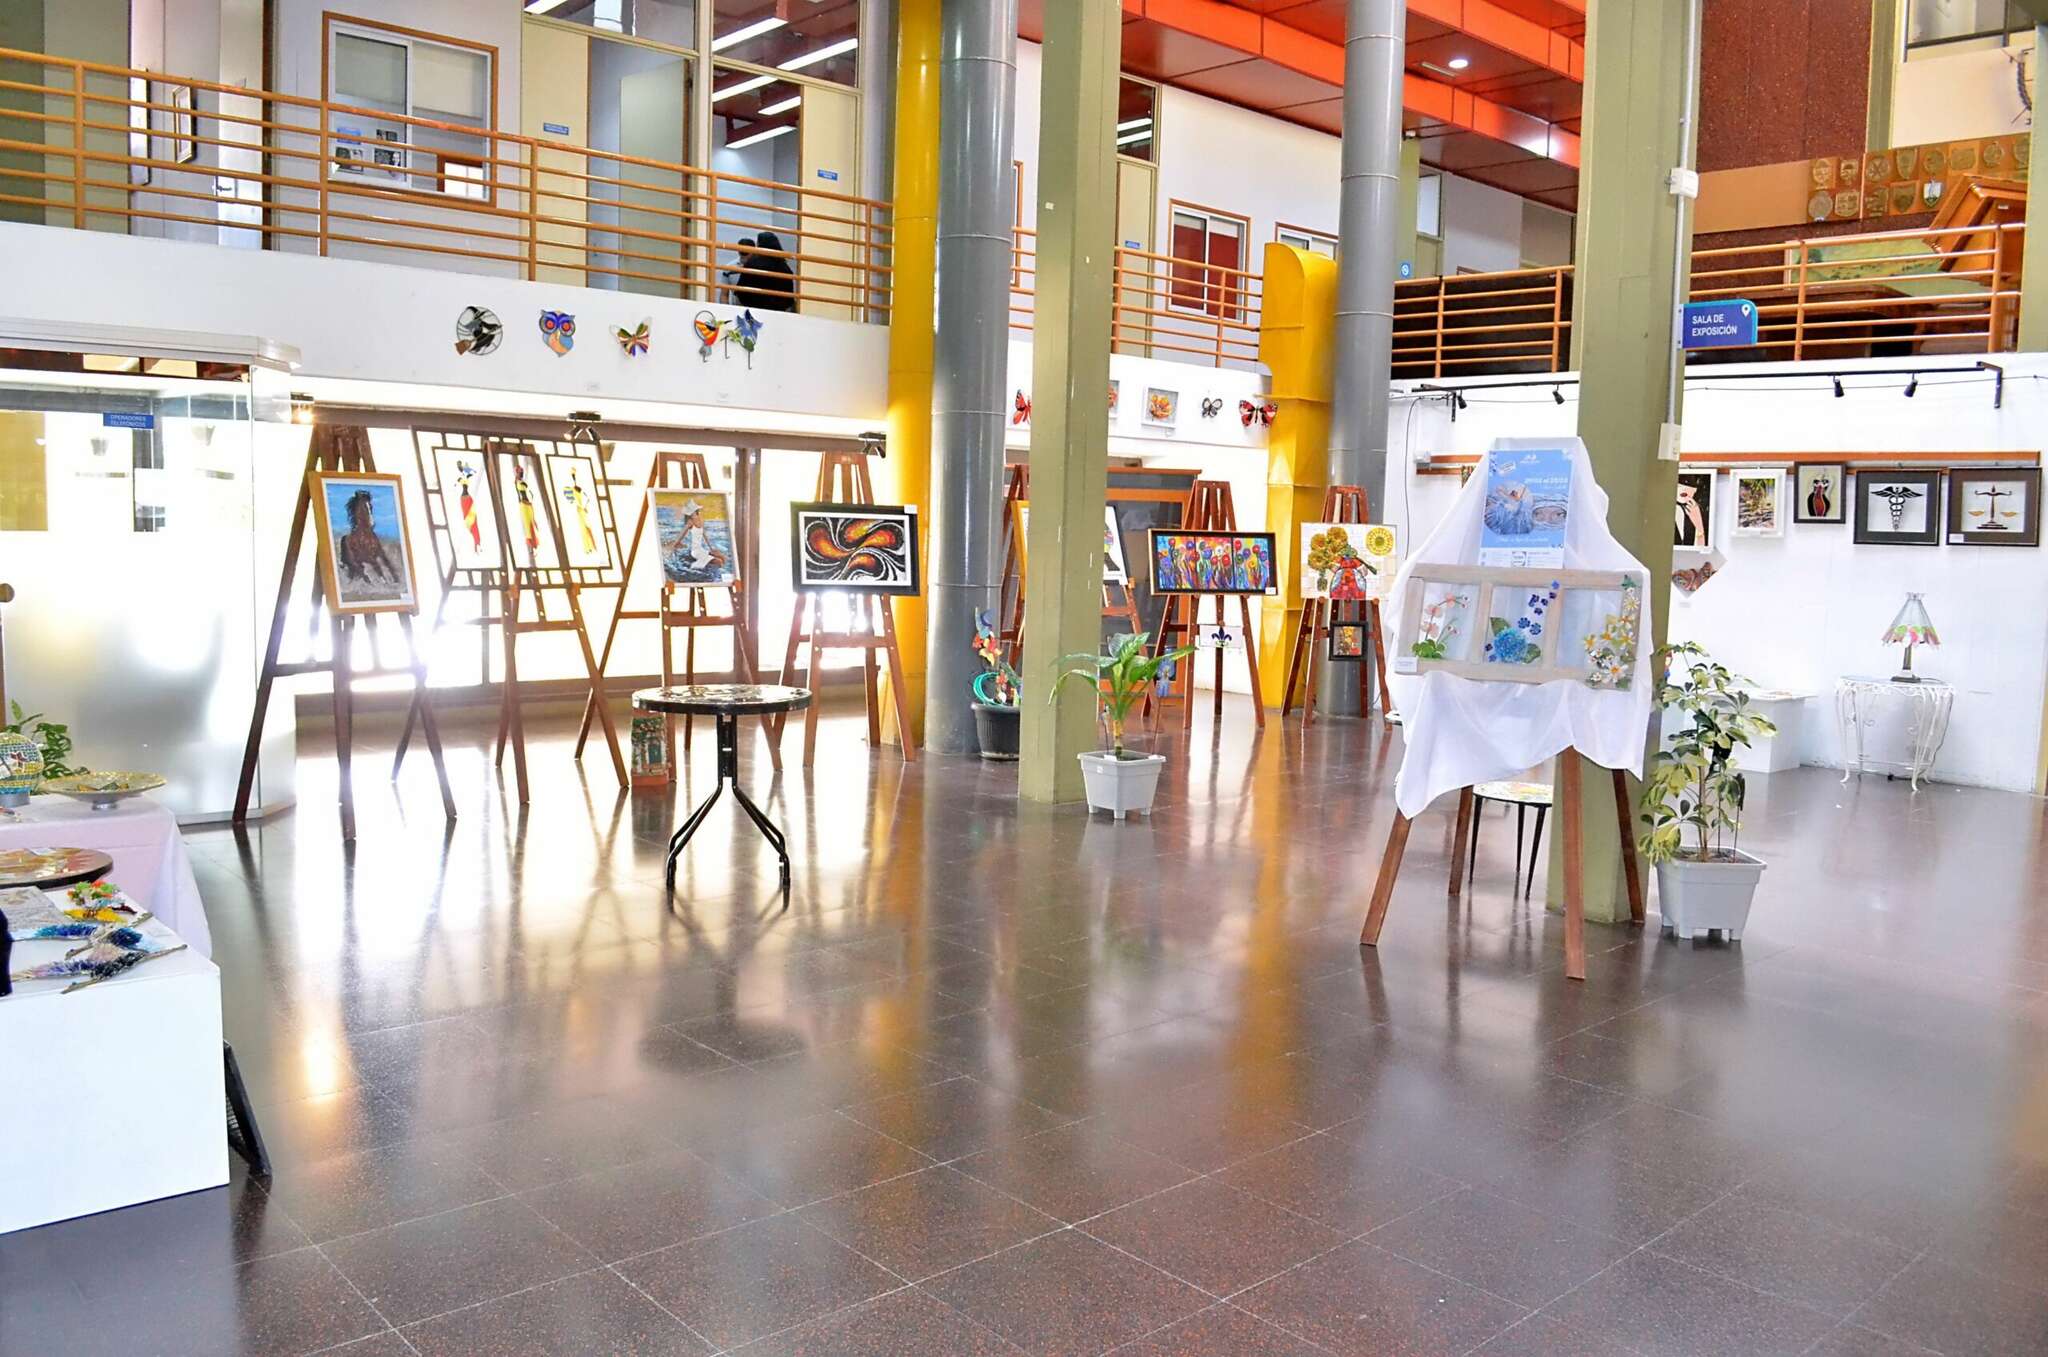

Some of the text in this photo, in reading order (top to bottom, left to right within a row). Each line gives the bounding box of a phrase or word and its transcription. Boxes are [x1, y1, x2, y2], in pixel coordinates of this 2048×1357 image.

[1692, 313, 1725, 324] SALA DE
[1692, 325, 1737, 337] EXPOSICIÓN
